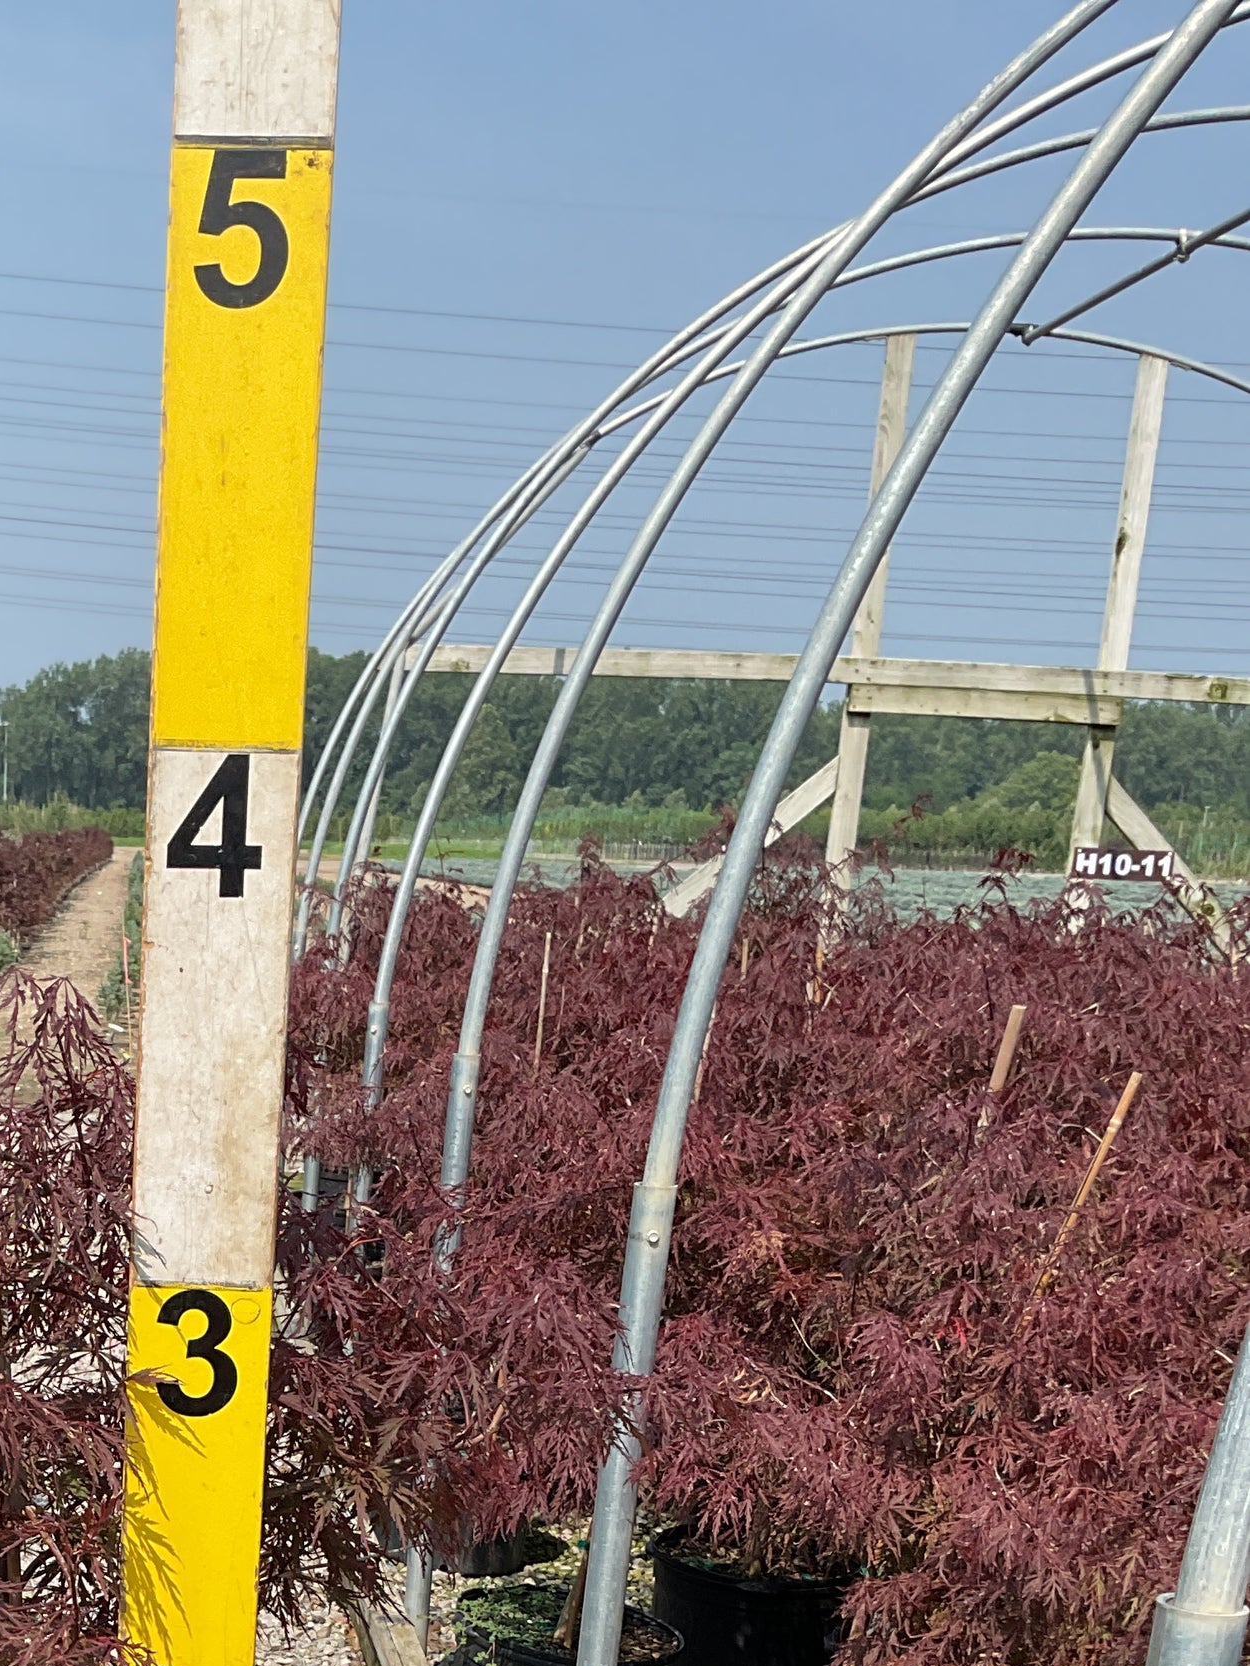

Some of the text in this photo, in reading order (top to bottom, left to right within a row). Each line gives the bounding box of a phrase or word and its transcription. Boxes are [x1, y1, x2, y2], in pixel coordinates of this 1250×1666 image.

[193, 149, 289, 309] 5
[166, 754, 263, 898] 4
[1075, 852, 1172, 877] H10-11
[156, 1289, 238, 1417] 3
